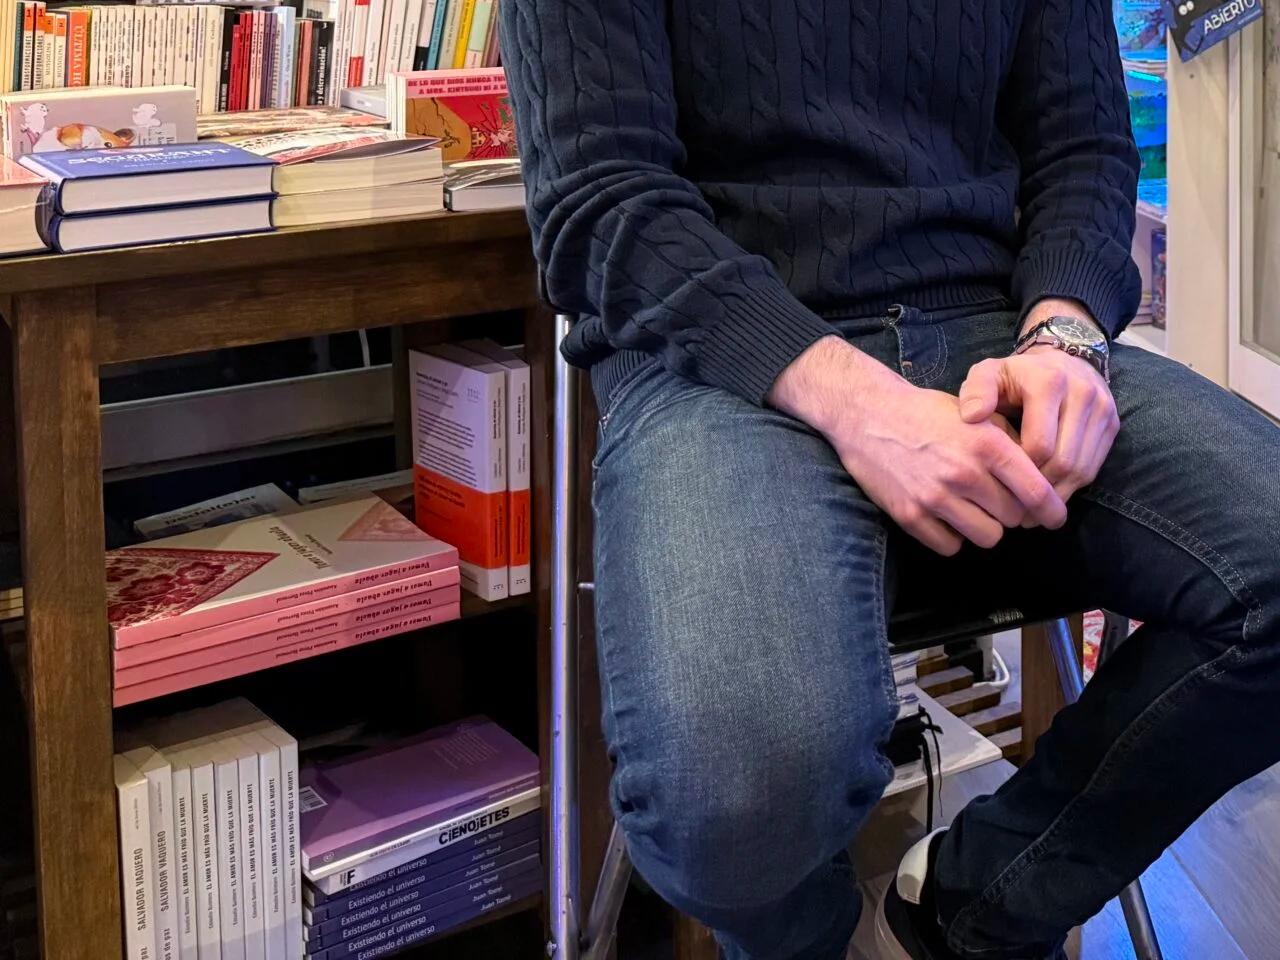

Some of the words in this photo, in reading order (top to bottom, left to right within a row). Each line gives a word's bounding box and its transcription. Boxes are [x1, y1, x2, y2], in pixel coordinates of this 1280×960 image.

[73, 26, 83, 68] ÚLTIMA
[134, 848, 144, 887] VAQUERO
[157, 831, 167, 869] VAQUERO
[135, 888, 146, 931] SALVADOR
[159, 870, 169, 912] SALVADOR
[341, 907, 378, 926] Existiendo
[380, 902, 387, 910] el
[390, 891, 419, 907] universo
[348, 890, 385, 910] Existiendo
[387, 885, 394, 894] el
[396, 875, 425, 892] universo
